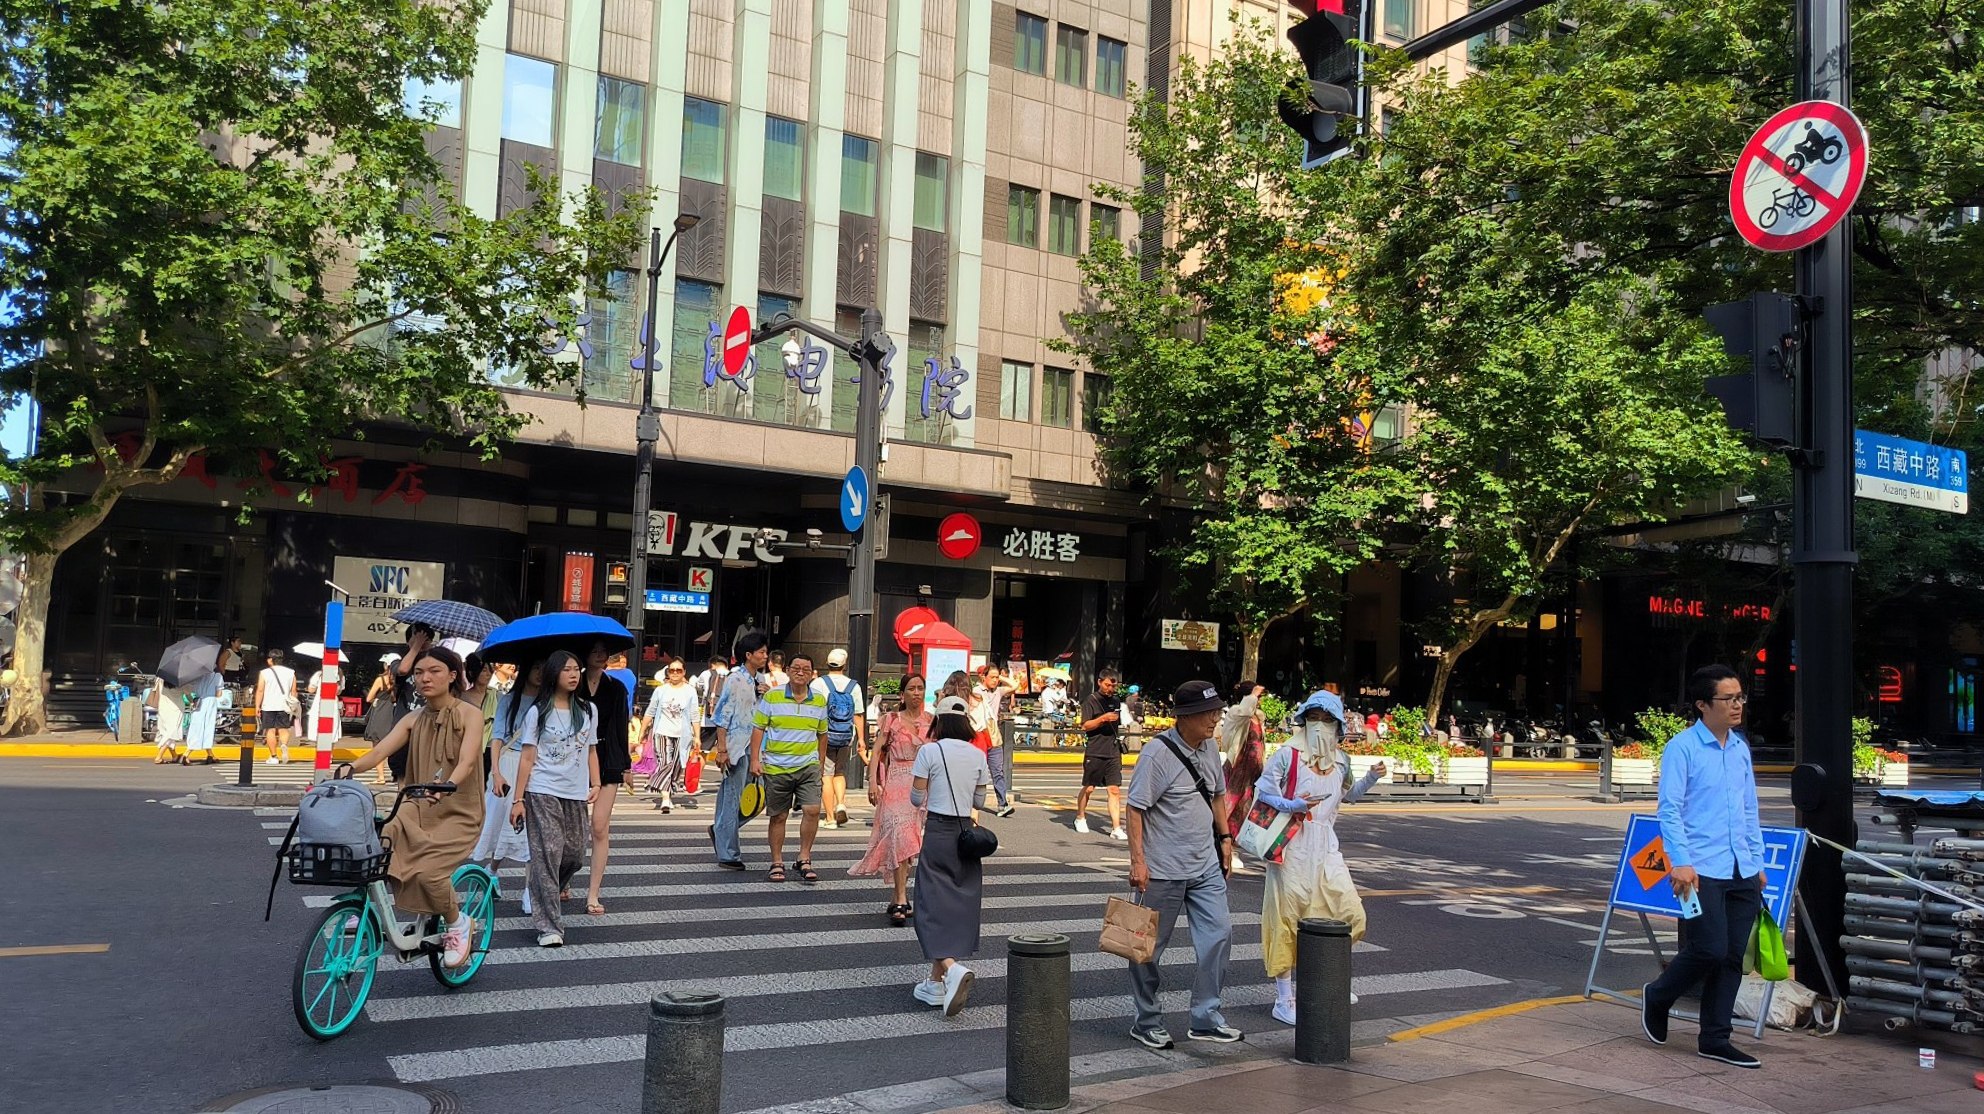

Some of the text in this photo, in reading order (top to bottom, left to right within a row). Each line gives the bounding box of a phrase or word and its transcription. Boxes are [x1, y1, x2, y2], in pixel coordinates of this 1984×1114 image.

[1876, 444, 1940, 480] 西藏中路
[1856, 478, 1863, 491] N
[1883, 483, 1908, 499] Xizang
[1953, 495, 1960, 508] S
[682, 521, 788, 563] KFC
[1003, 527, 1080, 562] 必胜客
[369, 564, 410, 595] SFC
[692, 568, 707, 588] K
